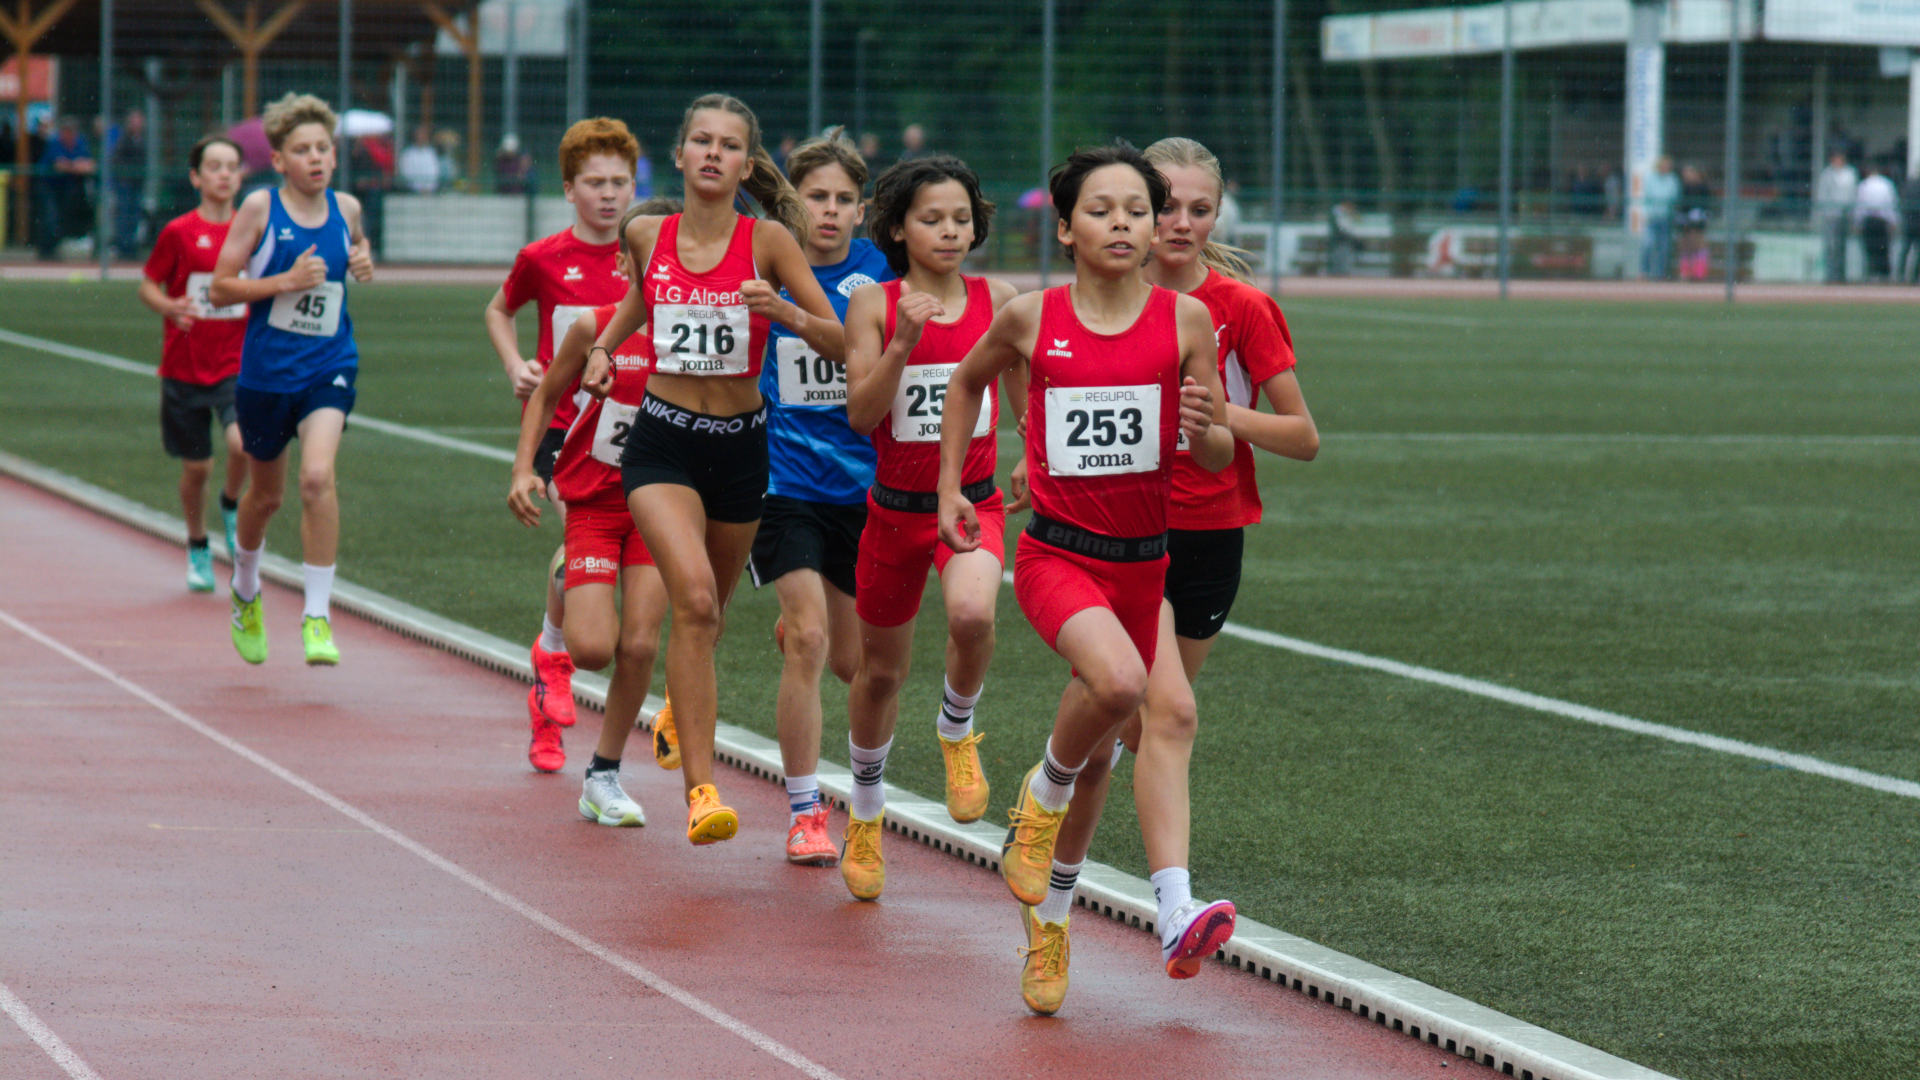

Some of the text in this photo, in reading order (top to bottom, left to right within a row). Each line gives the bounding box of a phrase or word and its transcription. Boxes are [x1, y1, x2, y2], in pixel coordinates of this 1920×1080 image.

[294, 294, 326, 318] 45
[655, 284, 682, 303] LG
[687, 309, 730, 320] REGUPOL
[671, 323, 735, 355] 216
[1085, 391, 1140, 402] REGUPOL
[641, 396, 692, 428] NIKE
[691, 417, 744, 435] PRO
[1066, 407, 1143, 447] 253
[1046, 523, 1127, 558] erima
